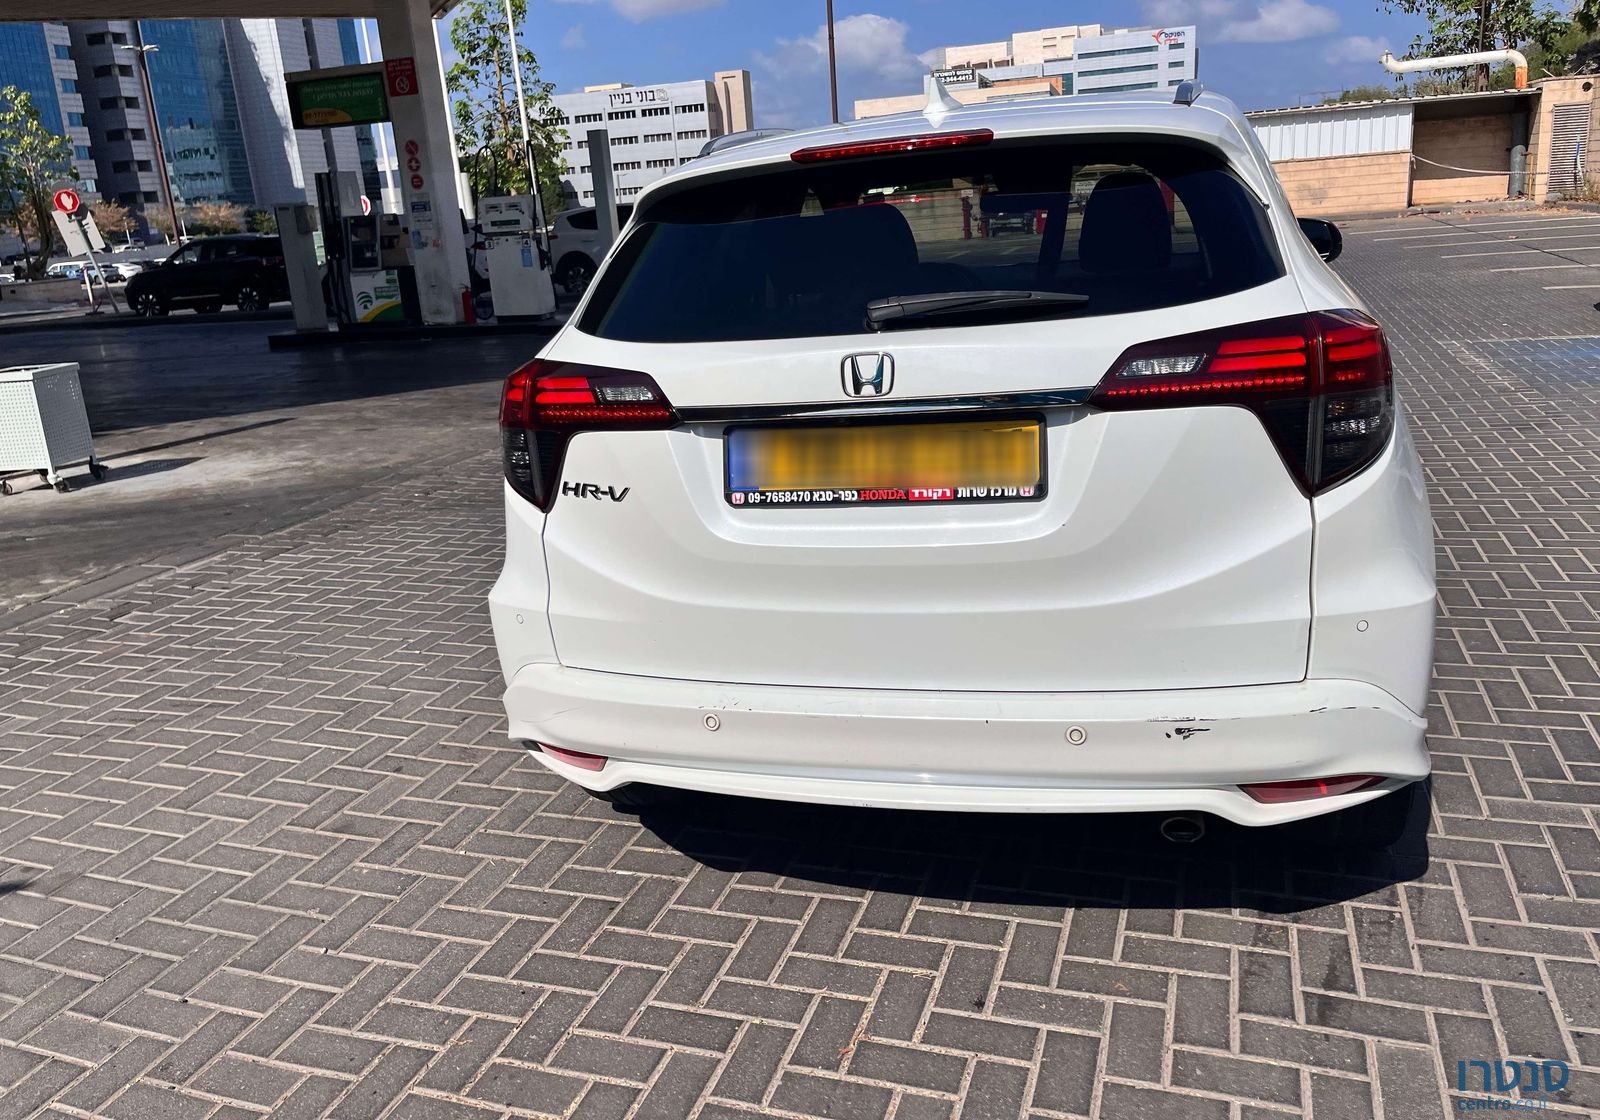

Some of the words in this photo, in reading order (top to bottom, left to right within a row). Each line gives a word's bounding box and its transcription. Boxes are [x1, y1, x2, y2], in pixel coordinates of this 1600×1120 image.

[941, 74, 973, 83] 2-344-4412
[608, 92, 633, 108] בניין
[635, 90, 656, 103] בוני
[561, 480, 631, 503] HR-V
[748, 491, 811, 504] 09-7658470
[812, 490, 858, 502] כפר-סבא
[860, 489, 907, 501] HONDA
[911, 487, 951, 500] רקורד
